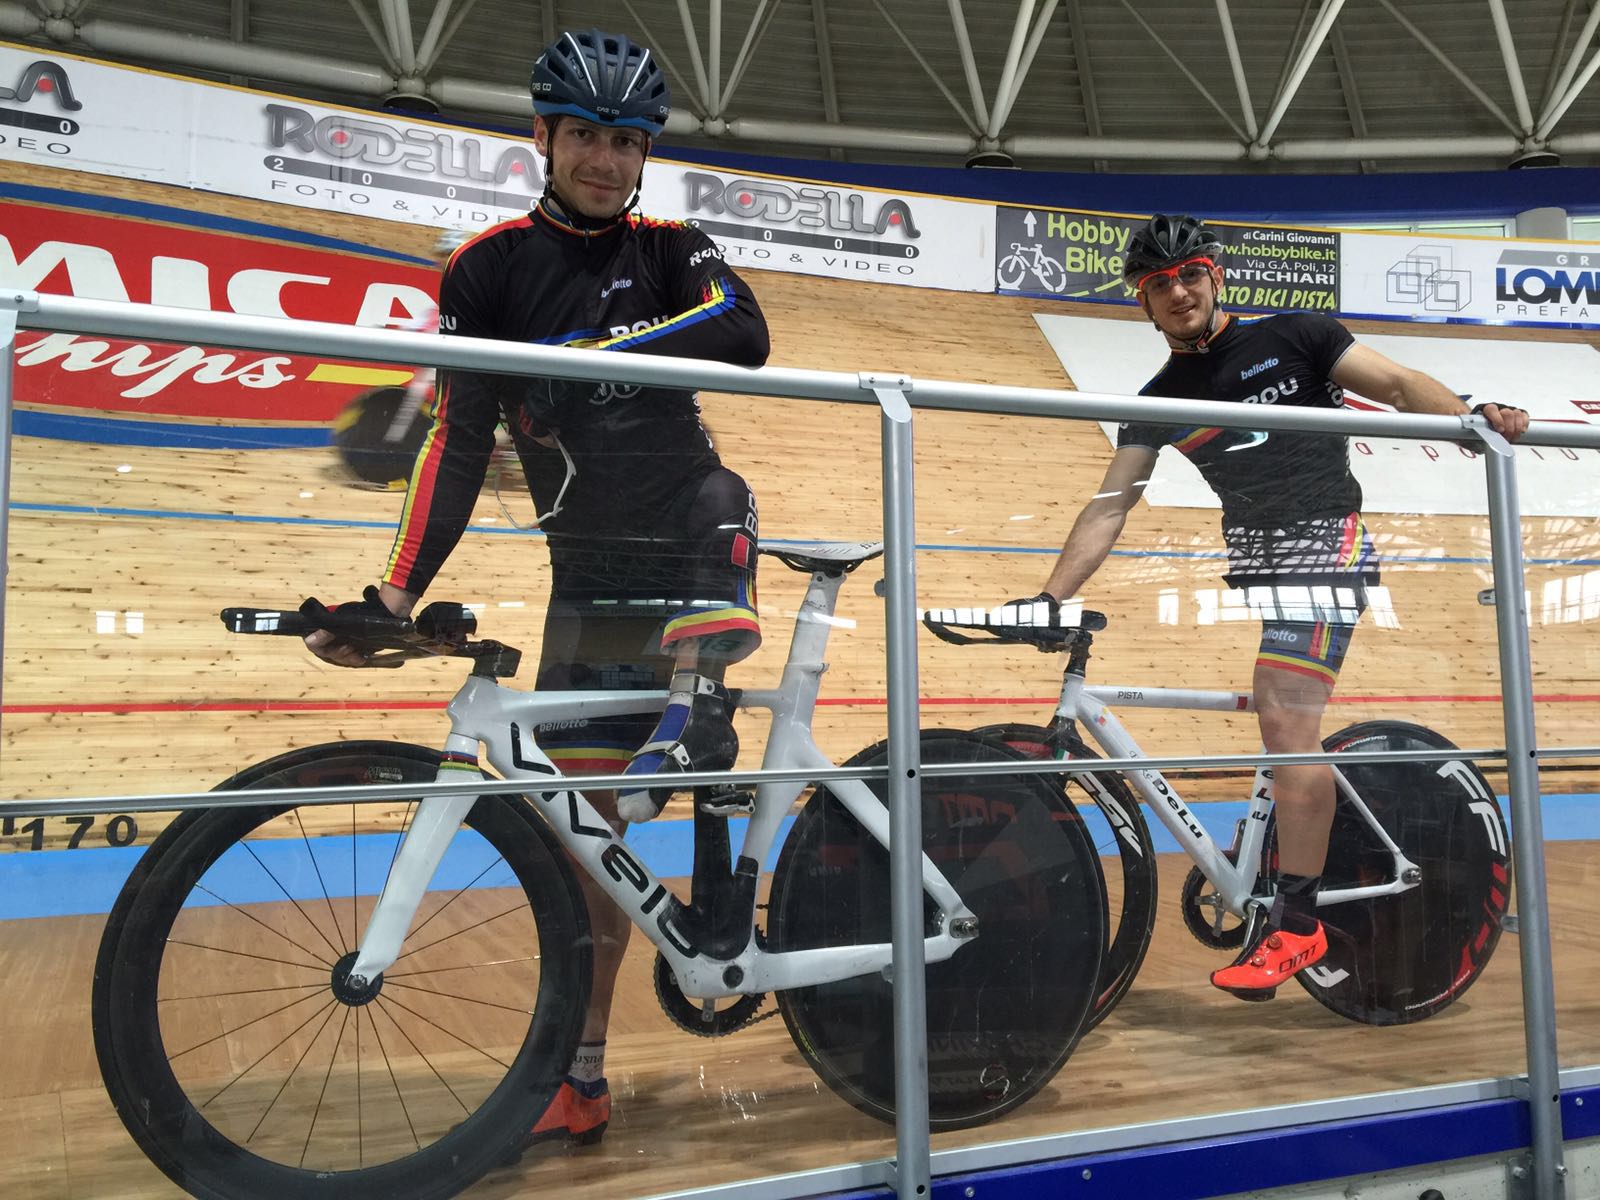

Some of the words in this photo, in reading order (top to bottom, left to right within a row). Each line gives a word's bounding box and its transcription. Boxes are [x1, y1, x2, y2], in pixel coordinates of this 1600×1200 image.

[266, 103, 545, 191] RODELLA
[271, 180, 370, 204] FOTO
[393, 200, 409, 211] &
[685, 171, 921, 238] RODELLA
[1048, 213, 1130, 250] Hobby
[1243, 232, 1251, 240] di
[1252, 231, 1284, 242] Carini
[1287, 233, 1335, 245] Giovanni
[789, 254, 803, 262] &
[822, 257, 914, 274] VIDEO
[1065, 247, 1123, 275] Bike
[1247, 260, 1265, 268] Via
[1268, 261, 1292, 270] G.A.
[1295, 262, 1319, 272] Poli,
[1322, 264, 1335, 273] 12
[1225, 269, 1335, 285] NTICHIARI
[1252, 288, 1287, 307] BICI
[1290, 290, 1337, 309] PISTA
[1241, 357, 1279, 381] bellotto
[1117, 691, 1144, 701] PISTA
